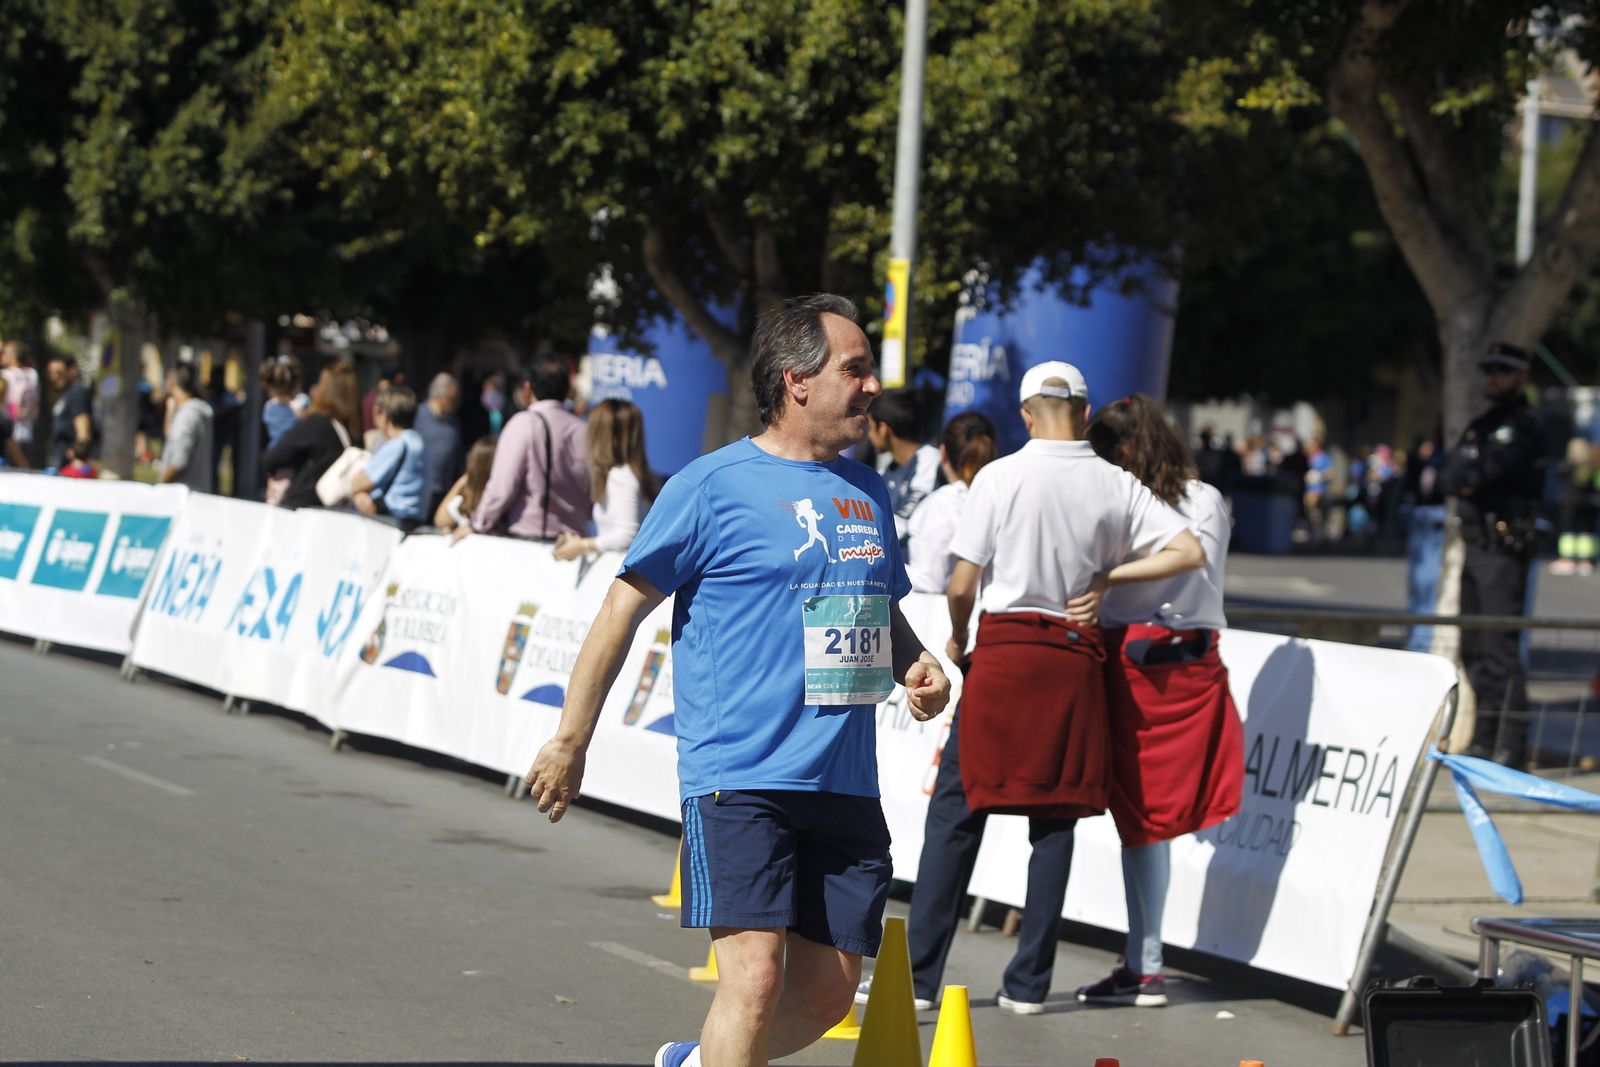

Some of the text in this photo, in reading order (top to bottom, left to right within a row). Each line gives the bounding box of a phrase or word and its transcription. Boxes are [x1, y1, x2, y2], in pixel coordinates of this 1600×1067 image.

[832, 498, 874, 521] VIII
[836, 524, 879, 536] CARRERA
[839, 540, 885, 565] mujer
[824, 628, 880, 654] 2181
[1245, 732, 1399, 818] ALMERÍA
